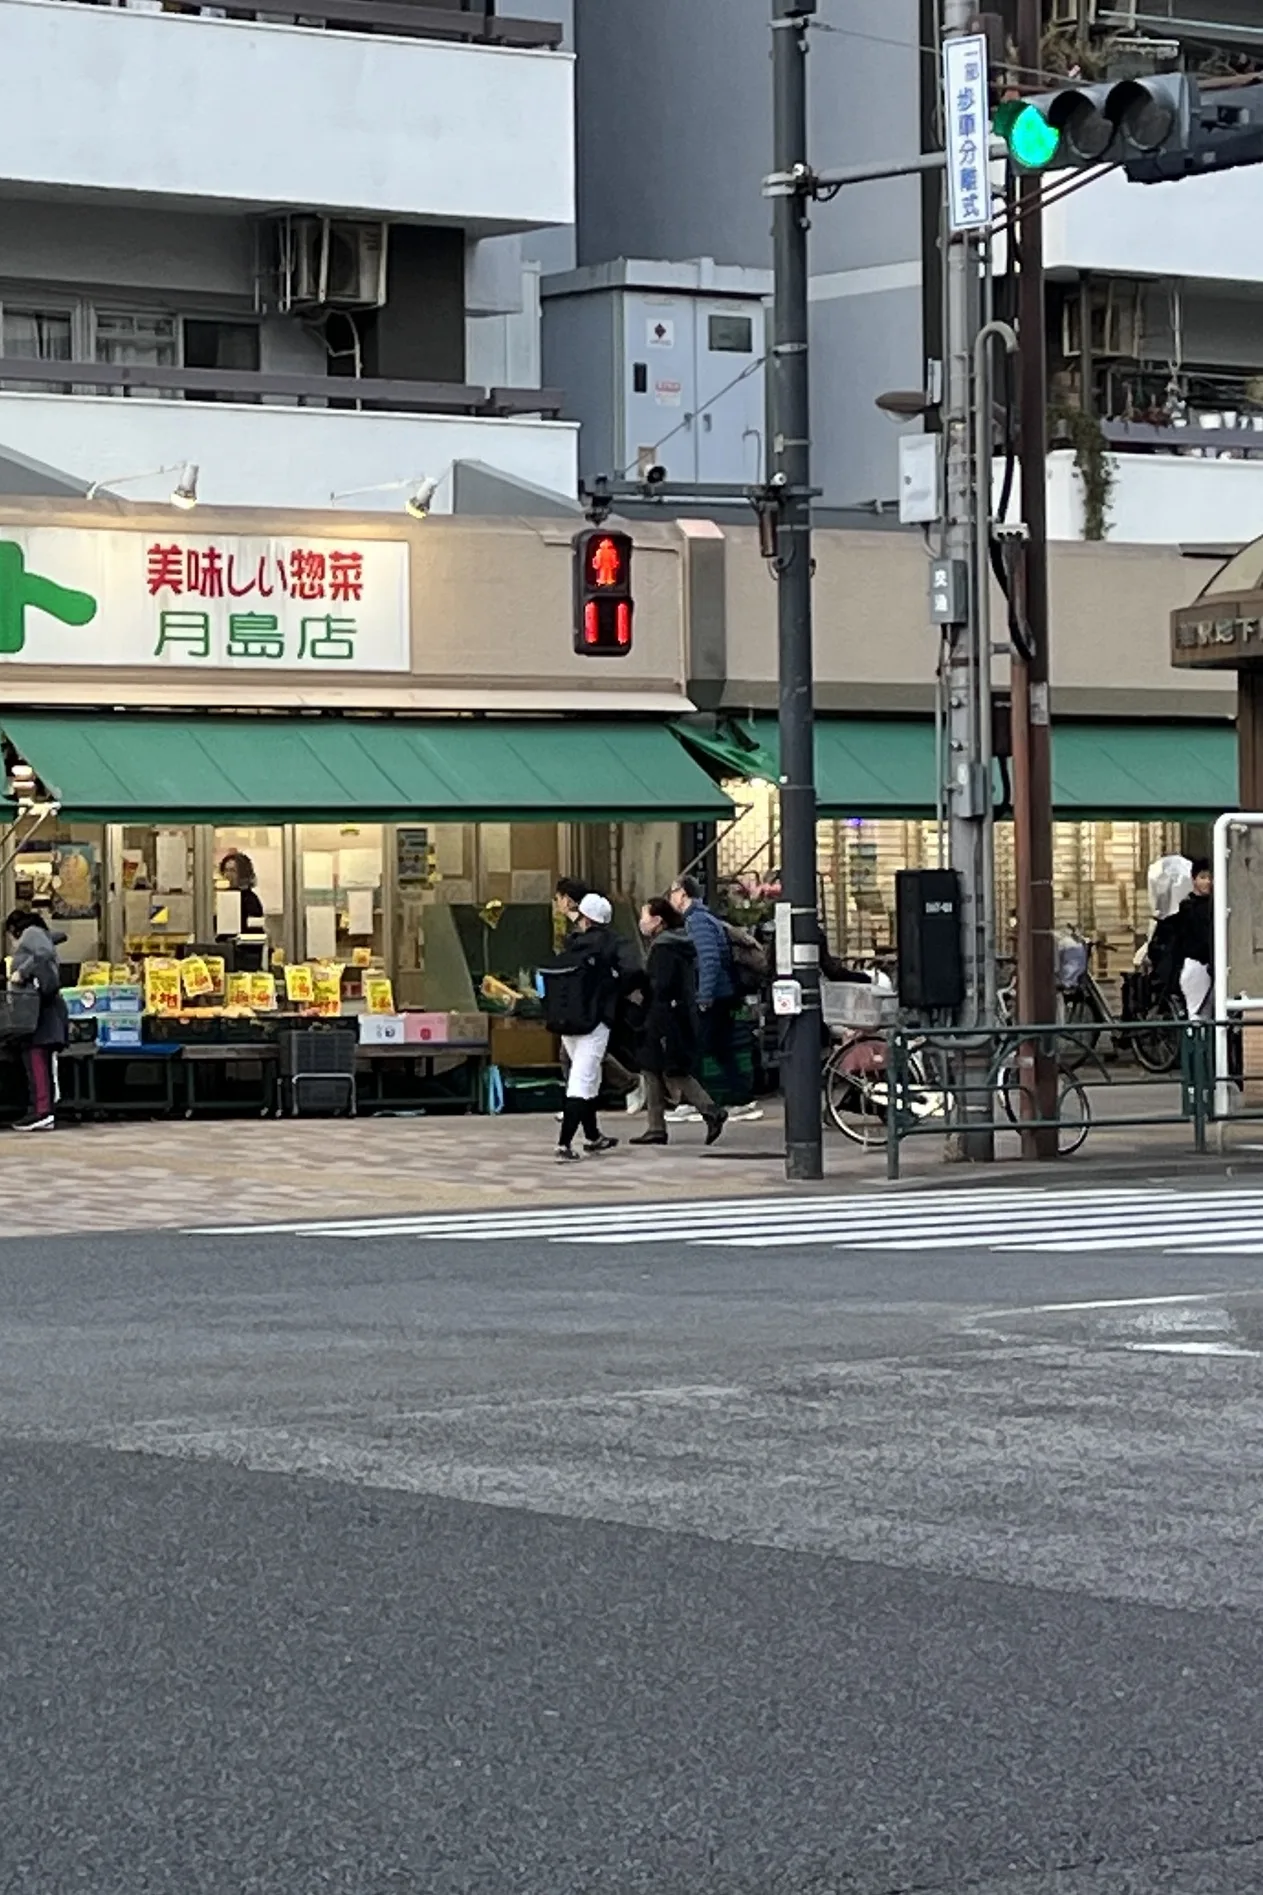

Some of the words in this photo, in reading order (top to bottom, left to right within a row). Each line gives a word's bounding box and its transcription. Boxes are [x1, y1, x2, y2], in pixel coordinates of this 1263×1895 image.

[147, 542, 364, 602] 美味しい惣菜
[154, 611, 358, 659] 月島店
